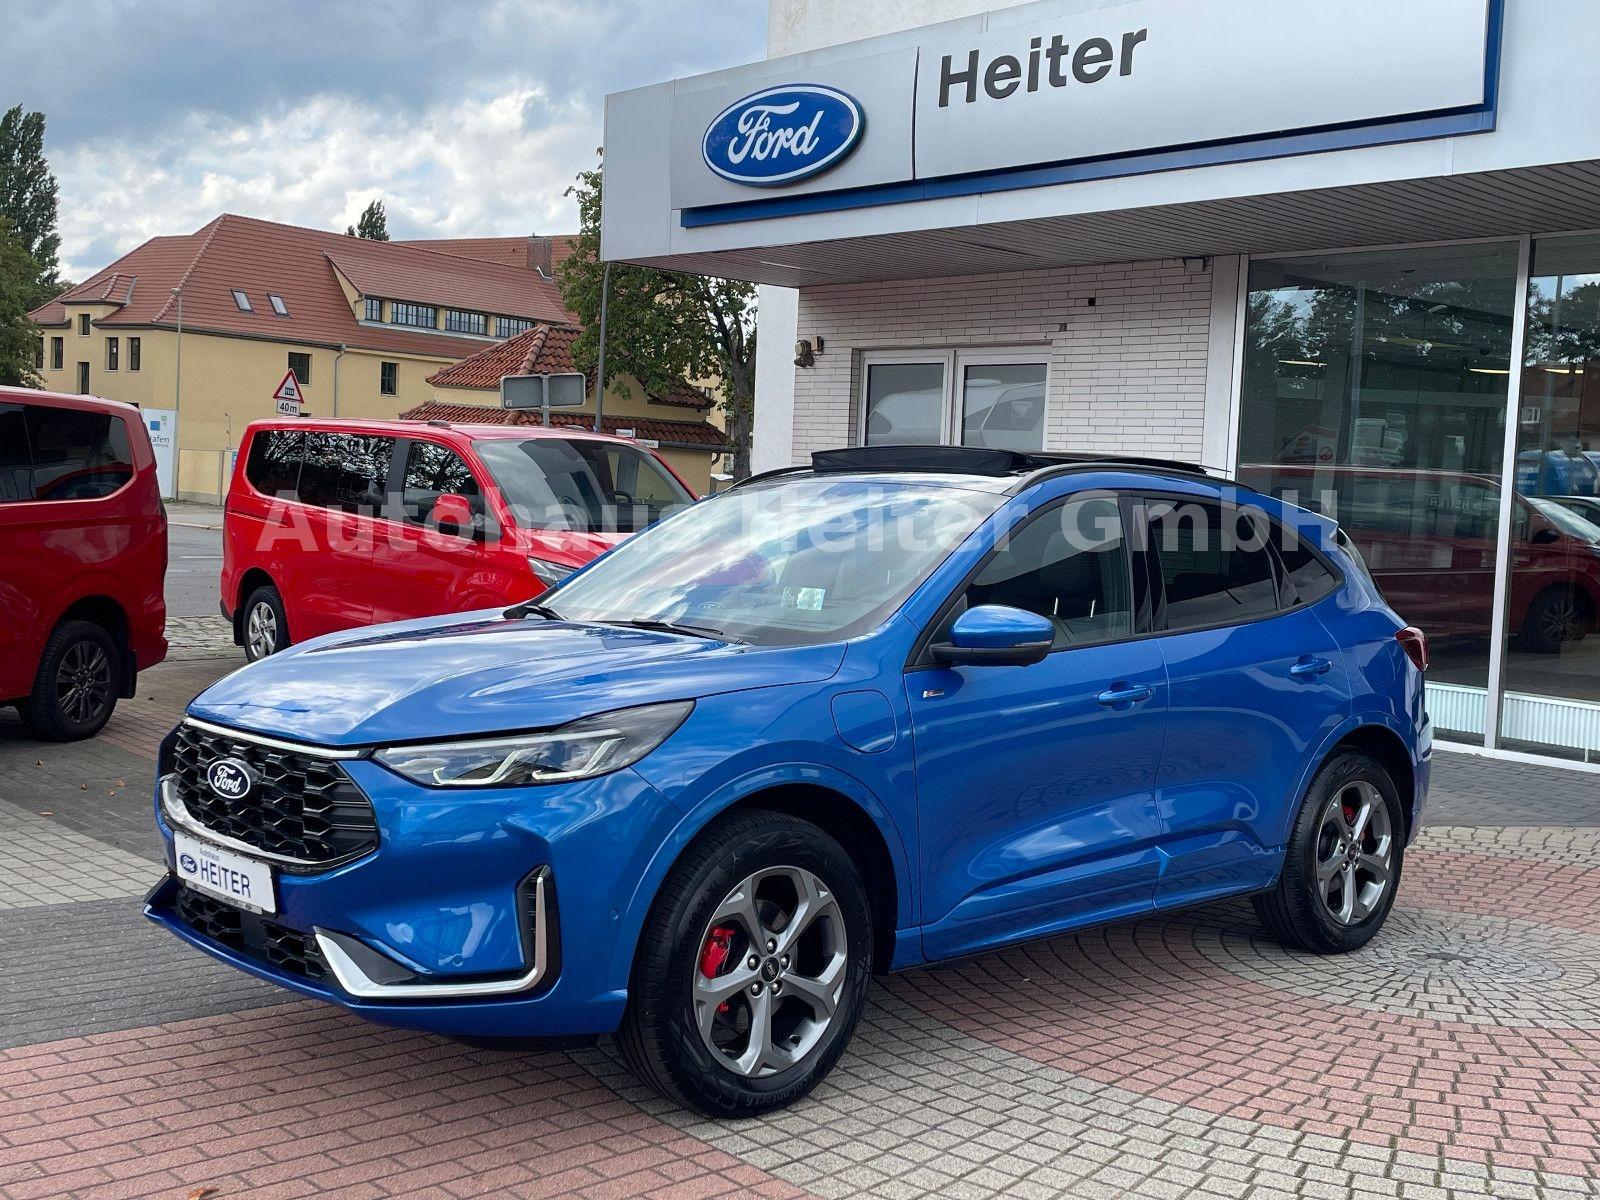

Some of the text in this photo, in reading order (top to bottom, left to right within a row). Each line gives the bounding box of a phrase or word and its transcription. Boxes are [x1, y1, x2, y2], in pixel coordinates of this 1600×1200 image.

[939, 28, 1148, 108] Heiter
[728, 101, 824, 164] Ford
[150, 434, 170, 443] afen
[213, 765, 241, 793] Ford
[200, 858, 251, 898] HEITER
